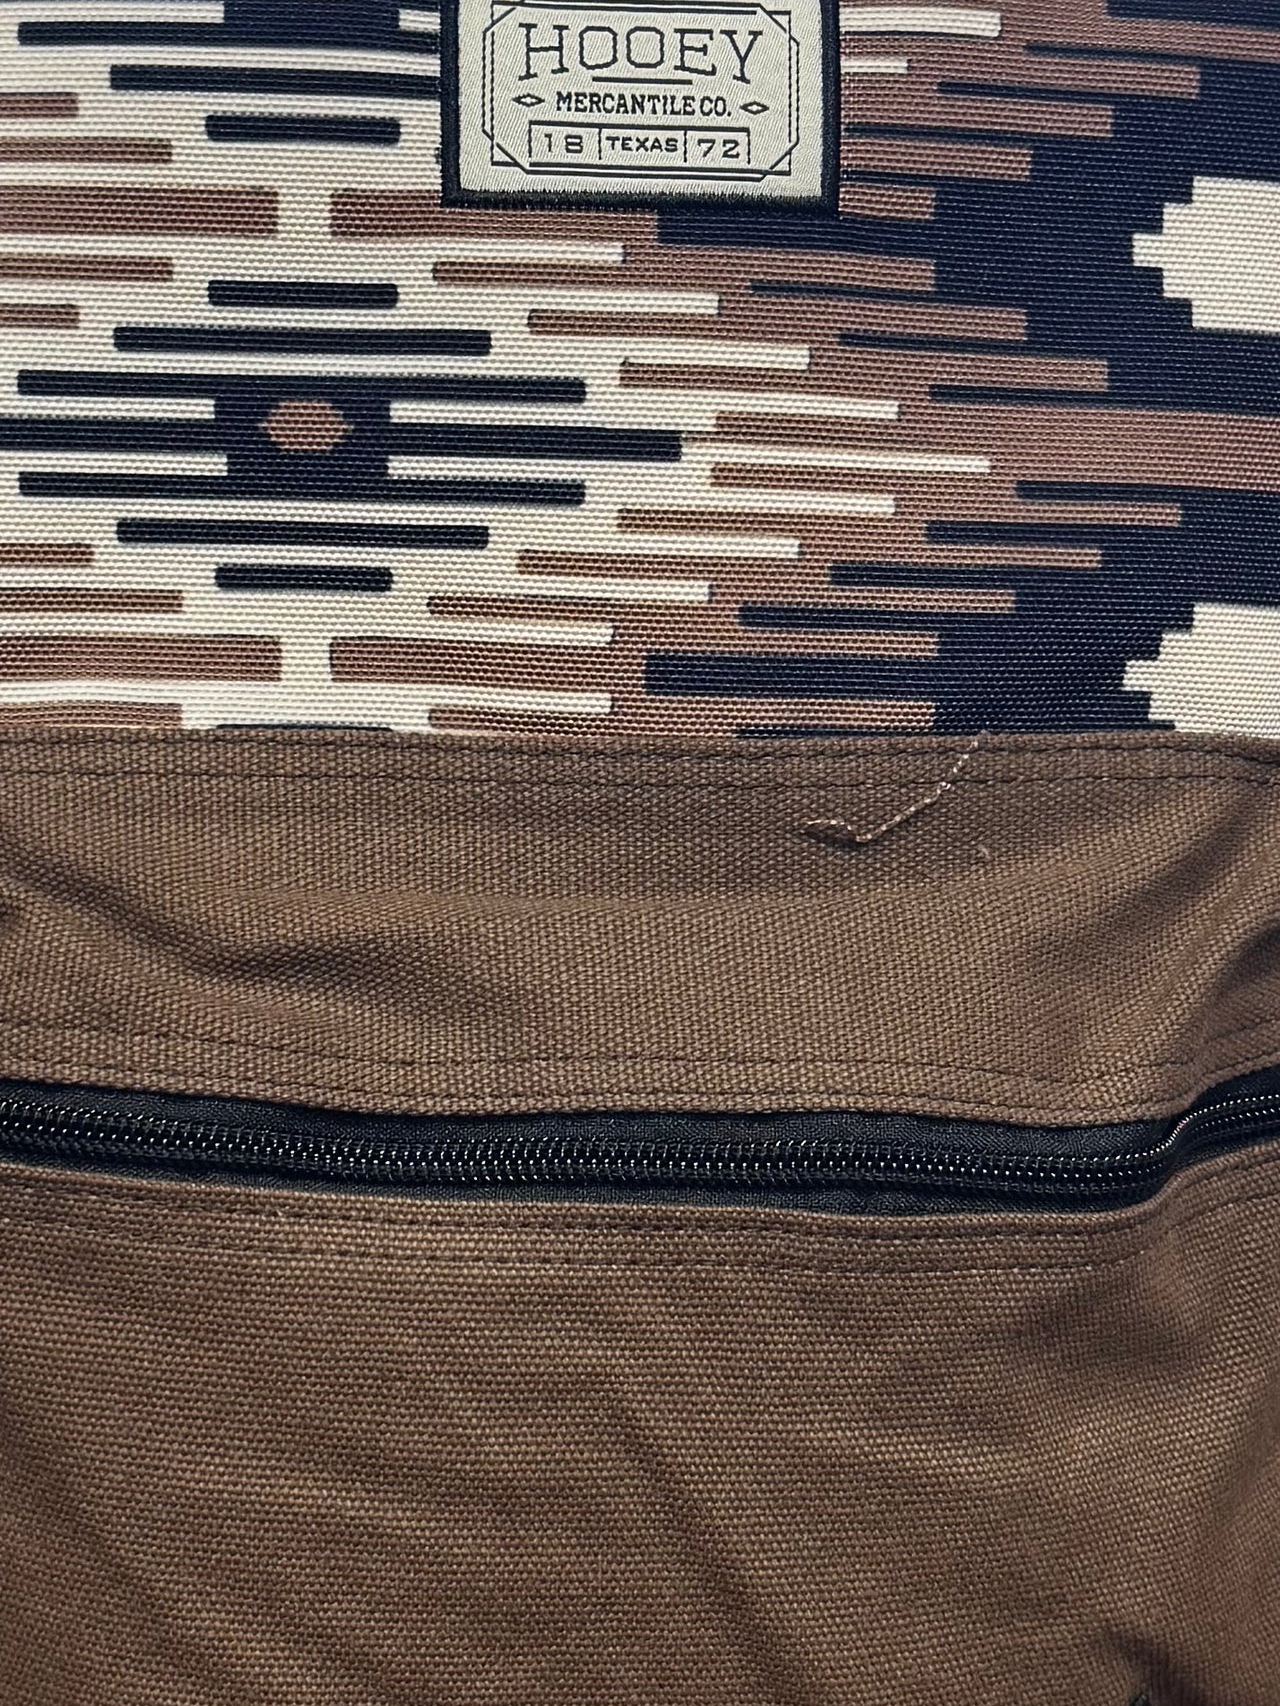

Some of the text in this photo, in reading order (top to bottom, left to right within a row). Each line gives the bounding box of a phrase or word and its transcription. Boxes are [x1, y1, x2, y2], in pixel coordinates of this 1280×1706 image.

[518, 22, 763, 85] HOOEY
[556, 91, 732, 118] MERCANTILE CO.
[605, 136, 679, 153] TEXAS
